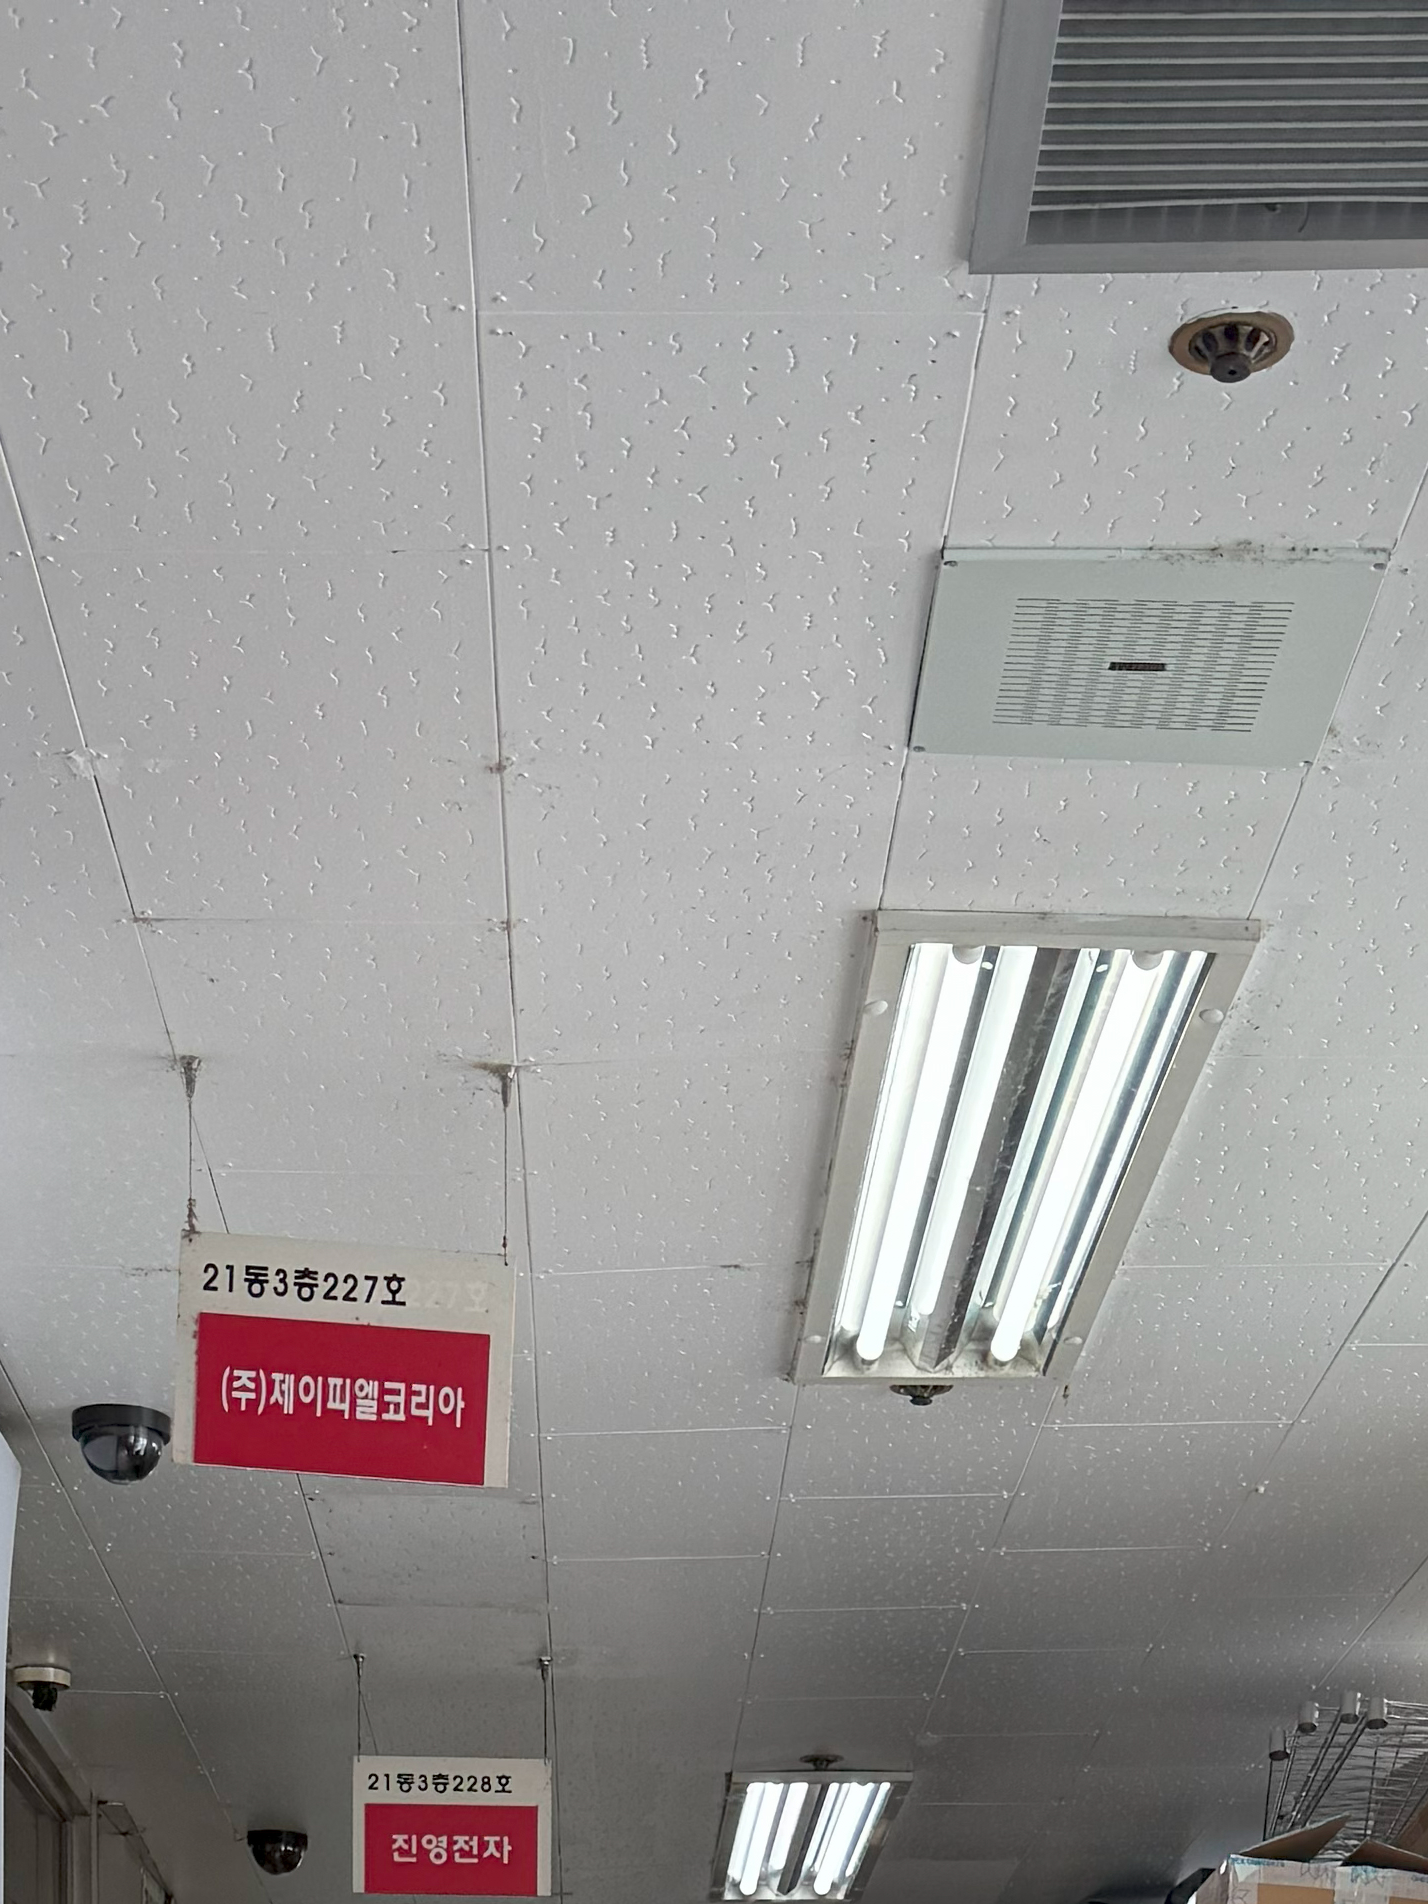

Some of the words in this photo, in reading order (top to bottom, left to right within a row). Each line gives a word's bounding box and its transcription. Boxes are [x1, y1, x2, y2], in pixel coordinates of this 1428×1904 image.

[202, 1262, 408, 1308] 21동3층227호
[222, 1368, 466, 1430] (주)제이피엘코리아
[367, 1771, 514, 1796] 21동3층228호
[390, 1832, 513, 1866] 진영전자
